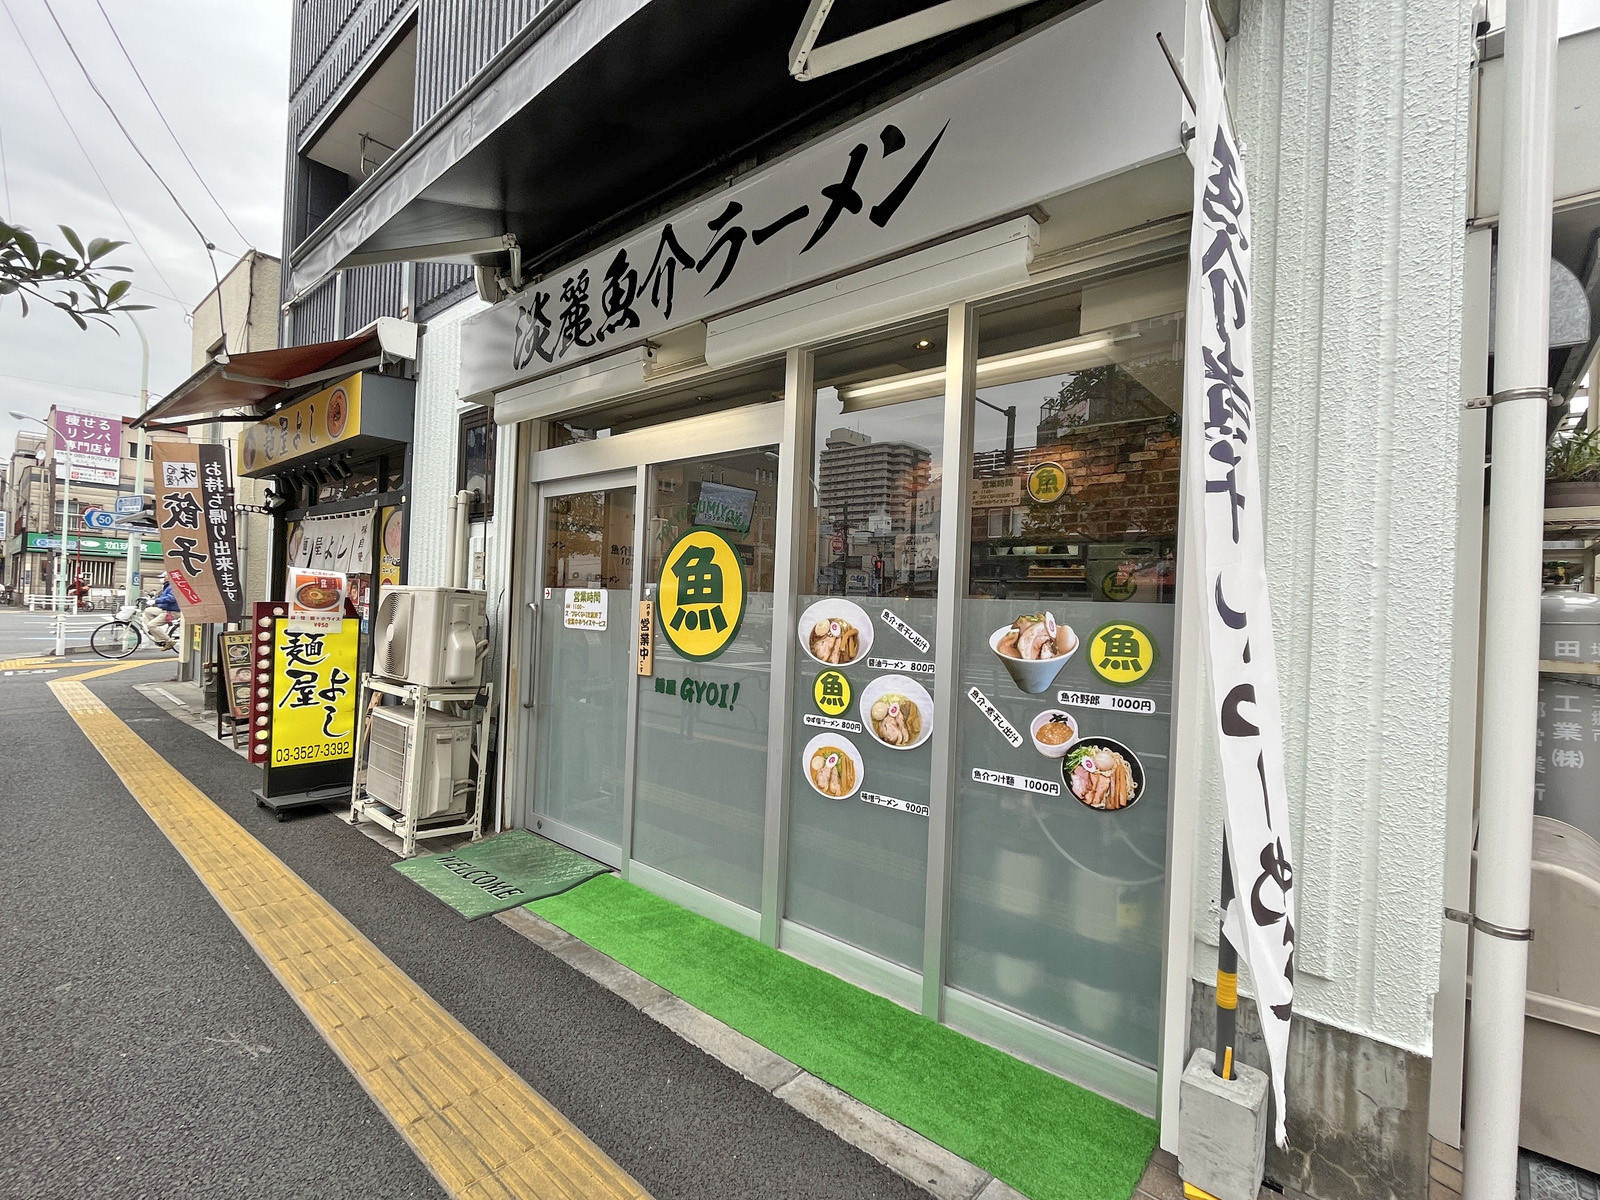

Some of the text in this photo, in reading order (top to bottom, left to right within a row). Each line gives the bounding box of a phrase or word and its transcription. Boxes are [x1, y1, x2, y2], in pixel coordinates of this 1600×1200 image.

[513, 118, 950, 370] 淡麗魚介ラーメン
[99, 516, 112, 524] 50
[573, 591, 601, 603] 営業時間
[670, 545, 728, 633] 魚
[868, 659, 935, 673] 醤油ラーメン 800円
[1100, 628, 1143, 672] 魚
[279, 629, 331, 708] 麺屋
[318, 668, 351, 737] よし
[680, 677, 740, 712] GYOI!
[820, 673, 845, 707] 魚
[1060, 692, 1152, 711] 魚介野郎 1000円
[841, 721, 861, 731] 800円
[970, 690, 1019, 744] 魚介・煮干し出汁
[276, 742, 350, 763] 03-3527-3392
[973, 769, 1059, 794] 魚介つけ麺 1000円
[905, 803, 929, 815] 900円
[433, 856, 526, 900] WELCOME
